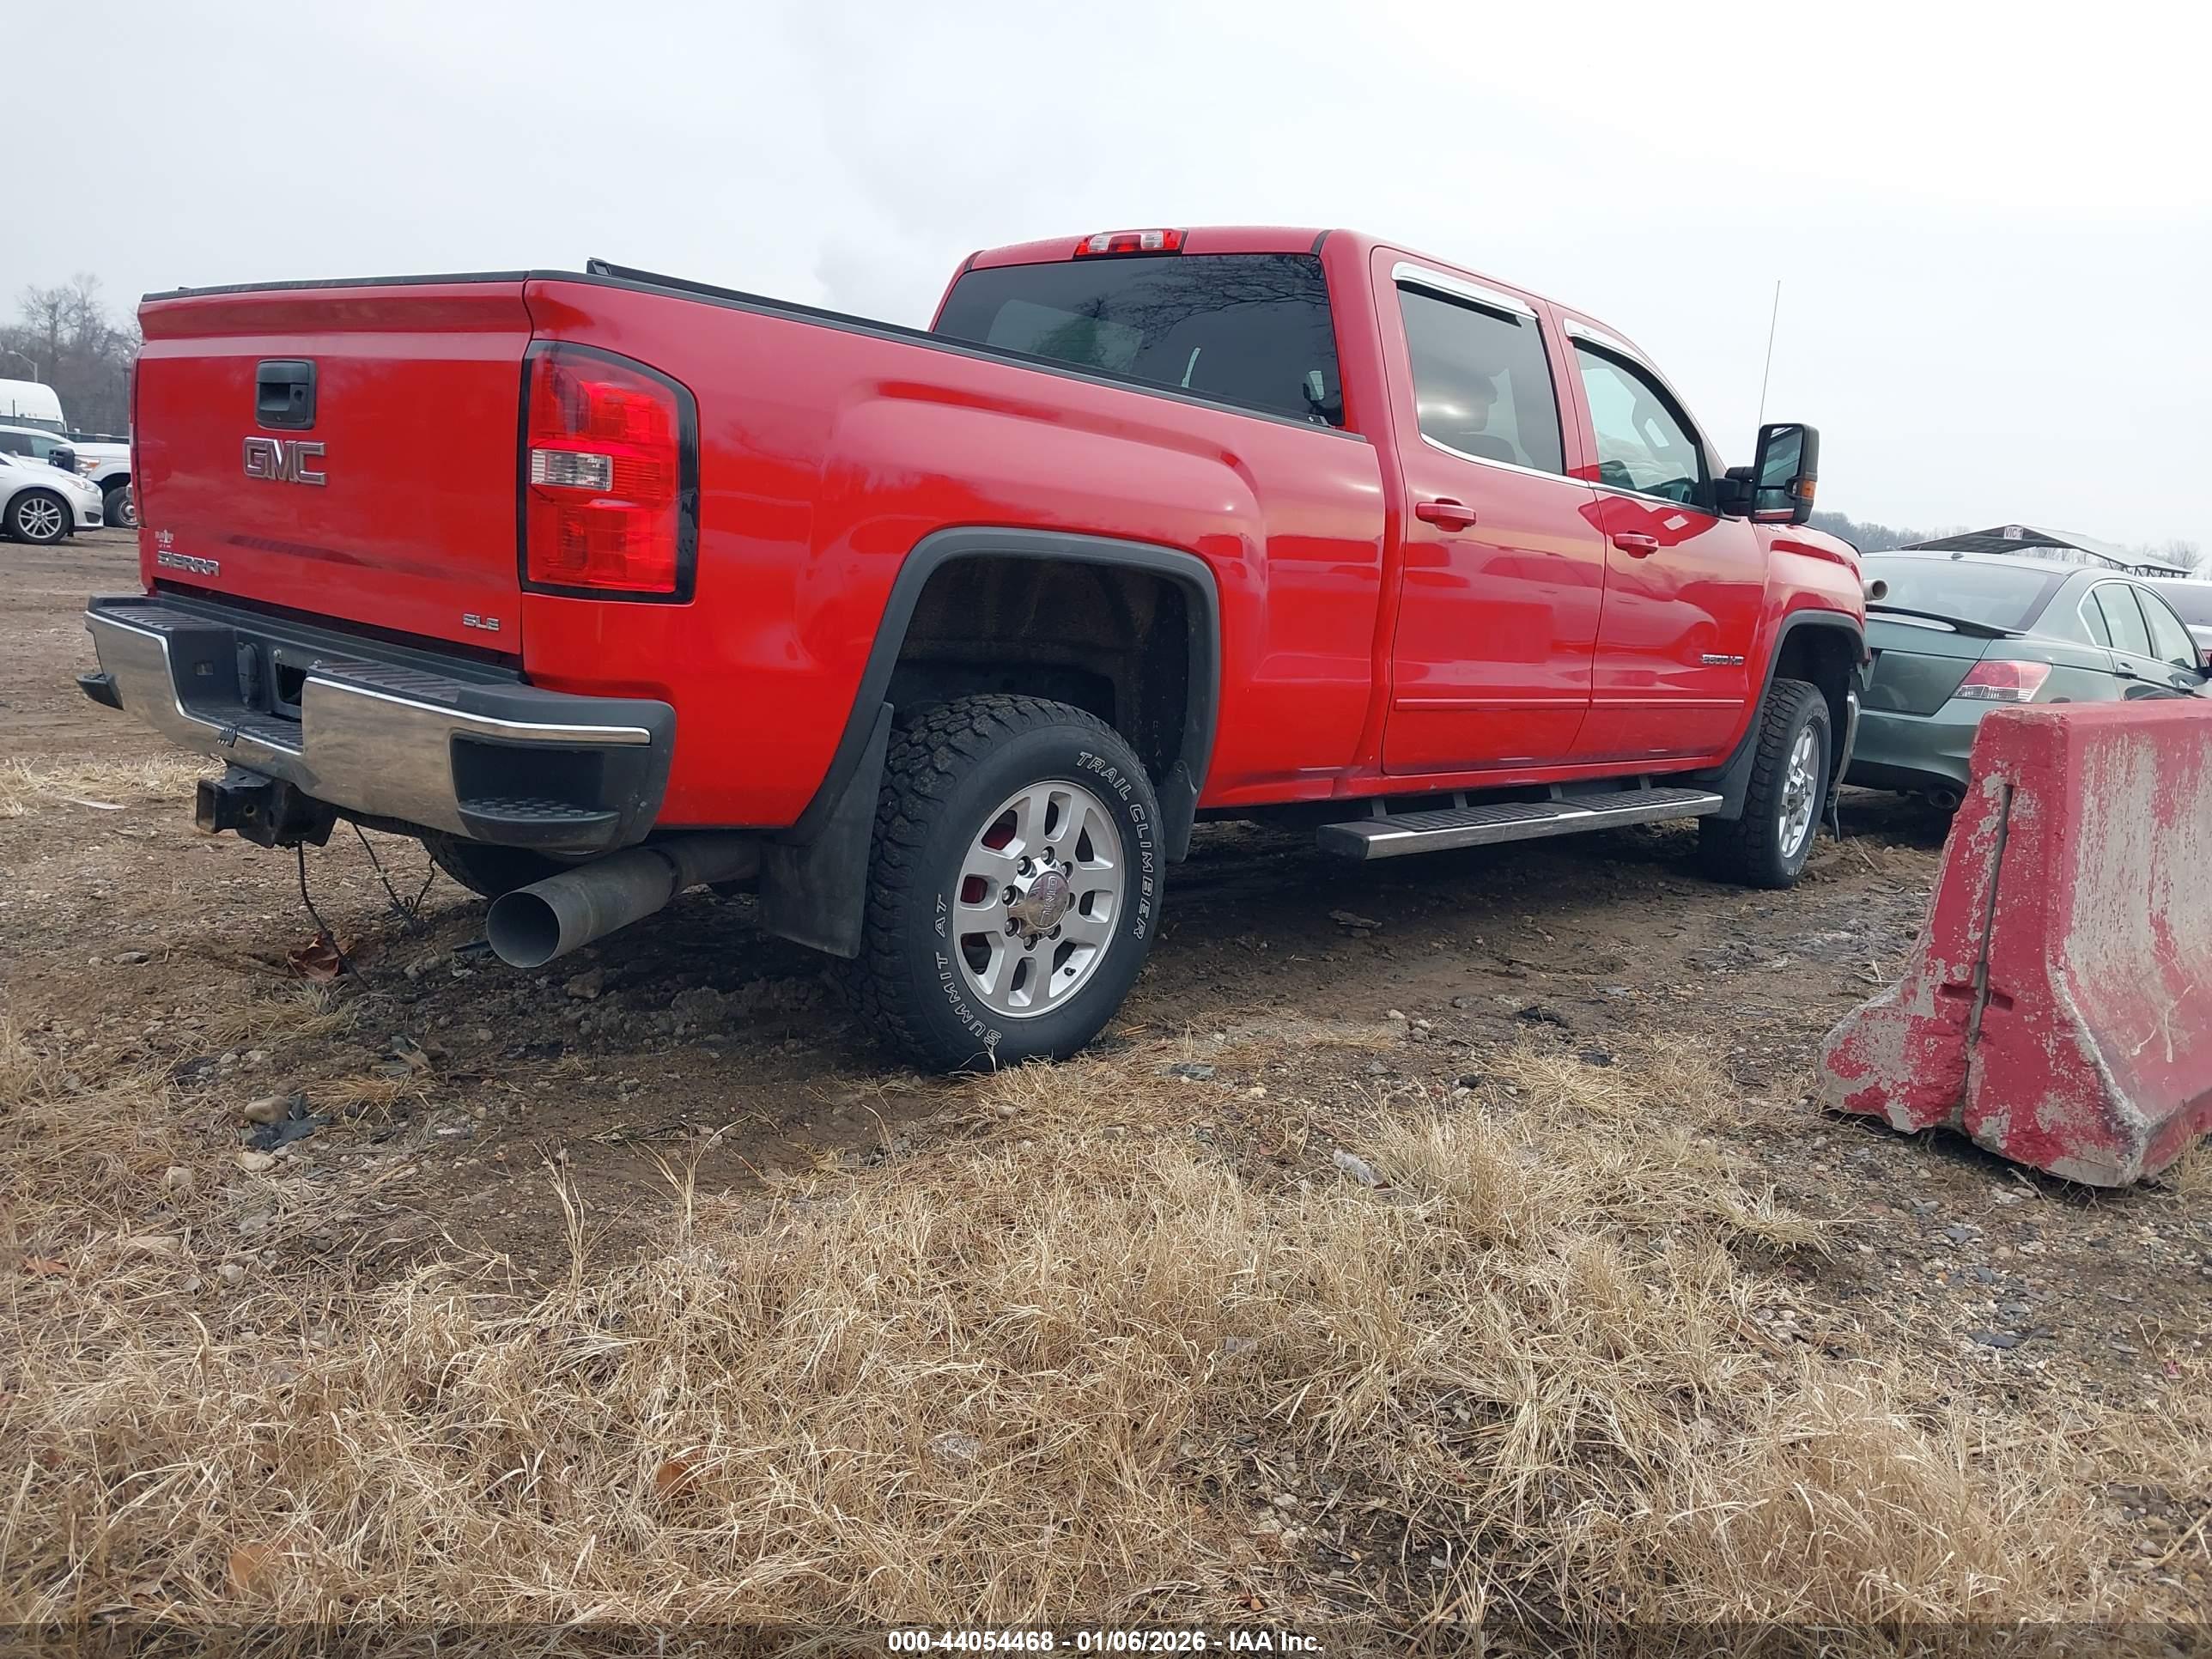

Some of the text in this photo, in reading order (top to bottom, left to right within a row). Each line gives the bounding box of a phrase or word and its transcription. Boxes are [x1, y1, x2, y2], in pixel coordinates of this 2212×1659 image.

[243, 436, 326, 486] GMC
[2006, 528, 2018, 538] VIC
[157, 550, 221, 577] SIERRA
[463, 613, 500, 632] SLE
[1077, 751, 1154, 940] TRAIL CLIMBER
[934, 893, 1002, 1048] SUMMIT AT
